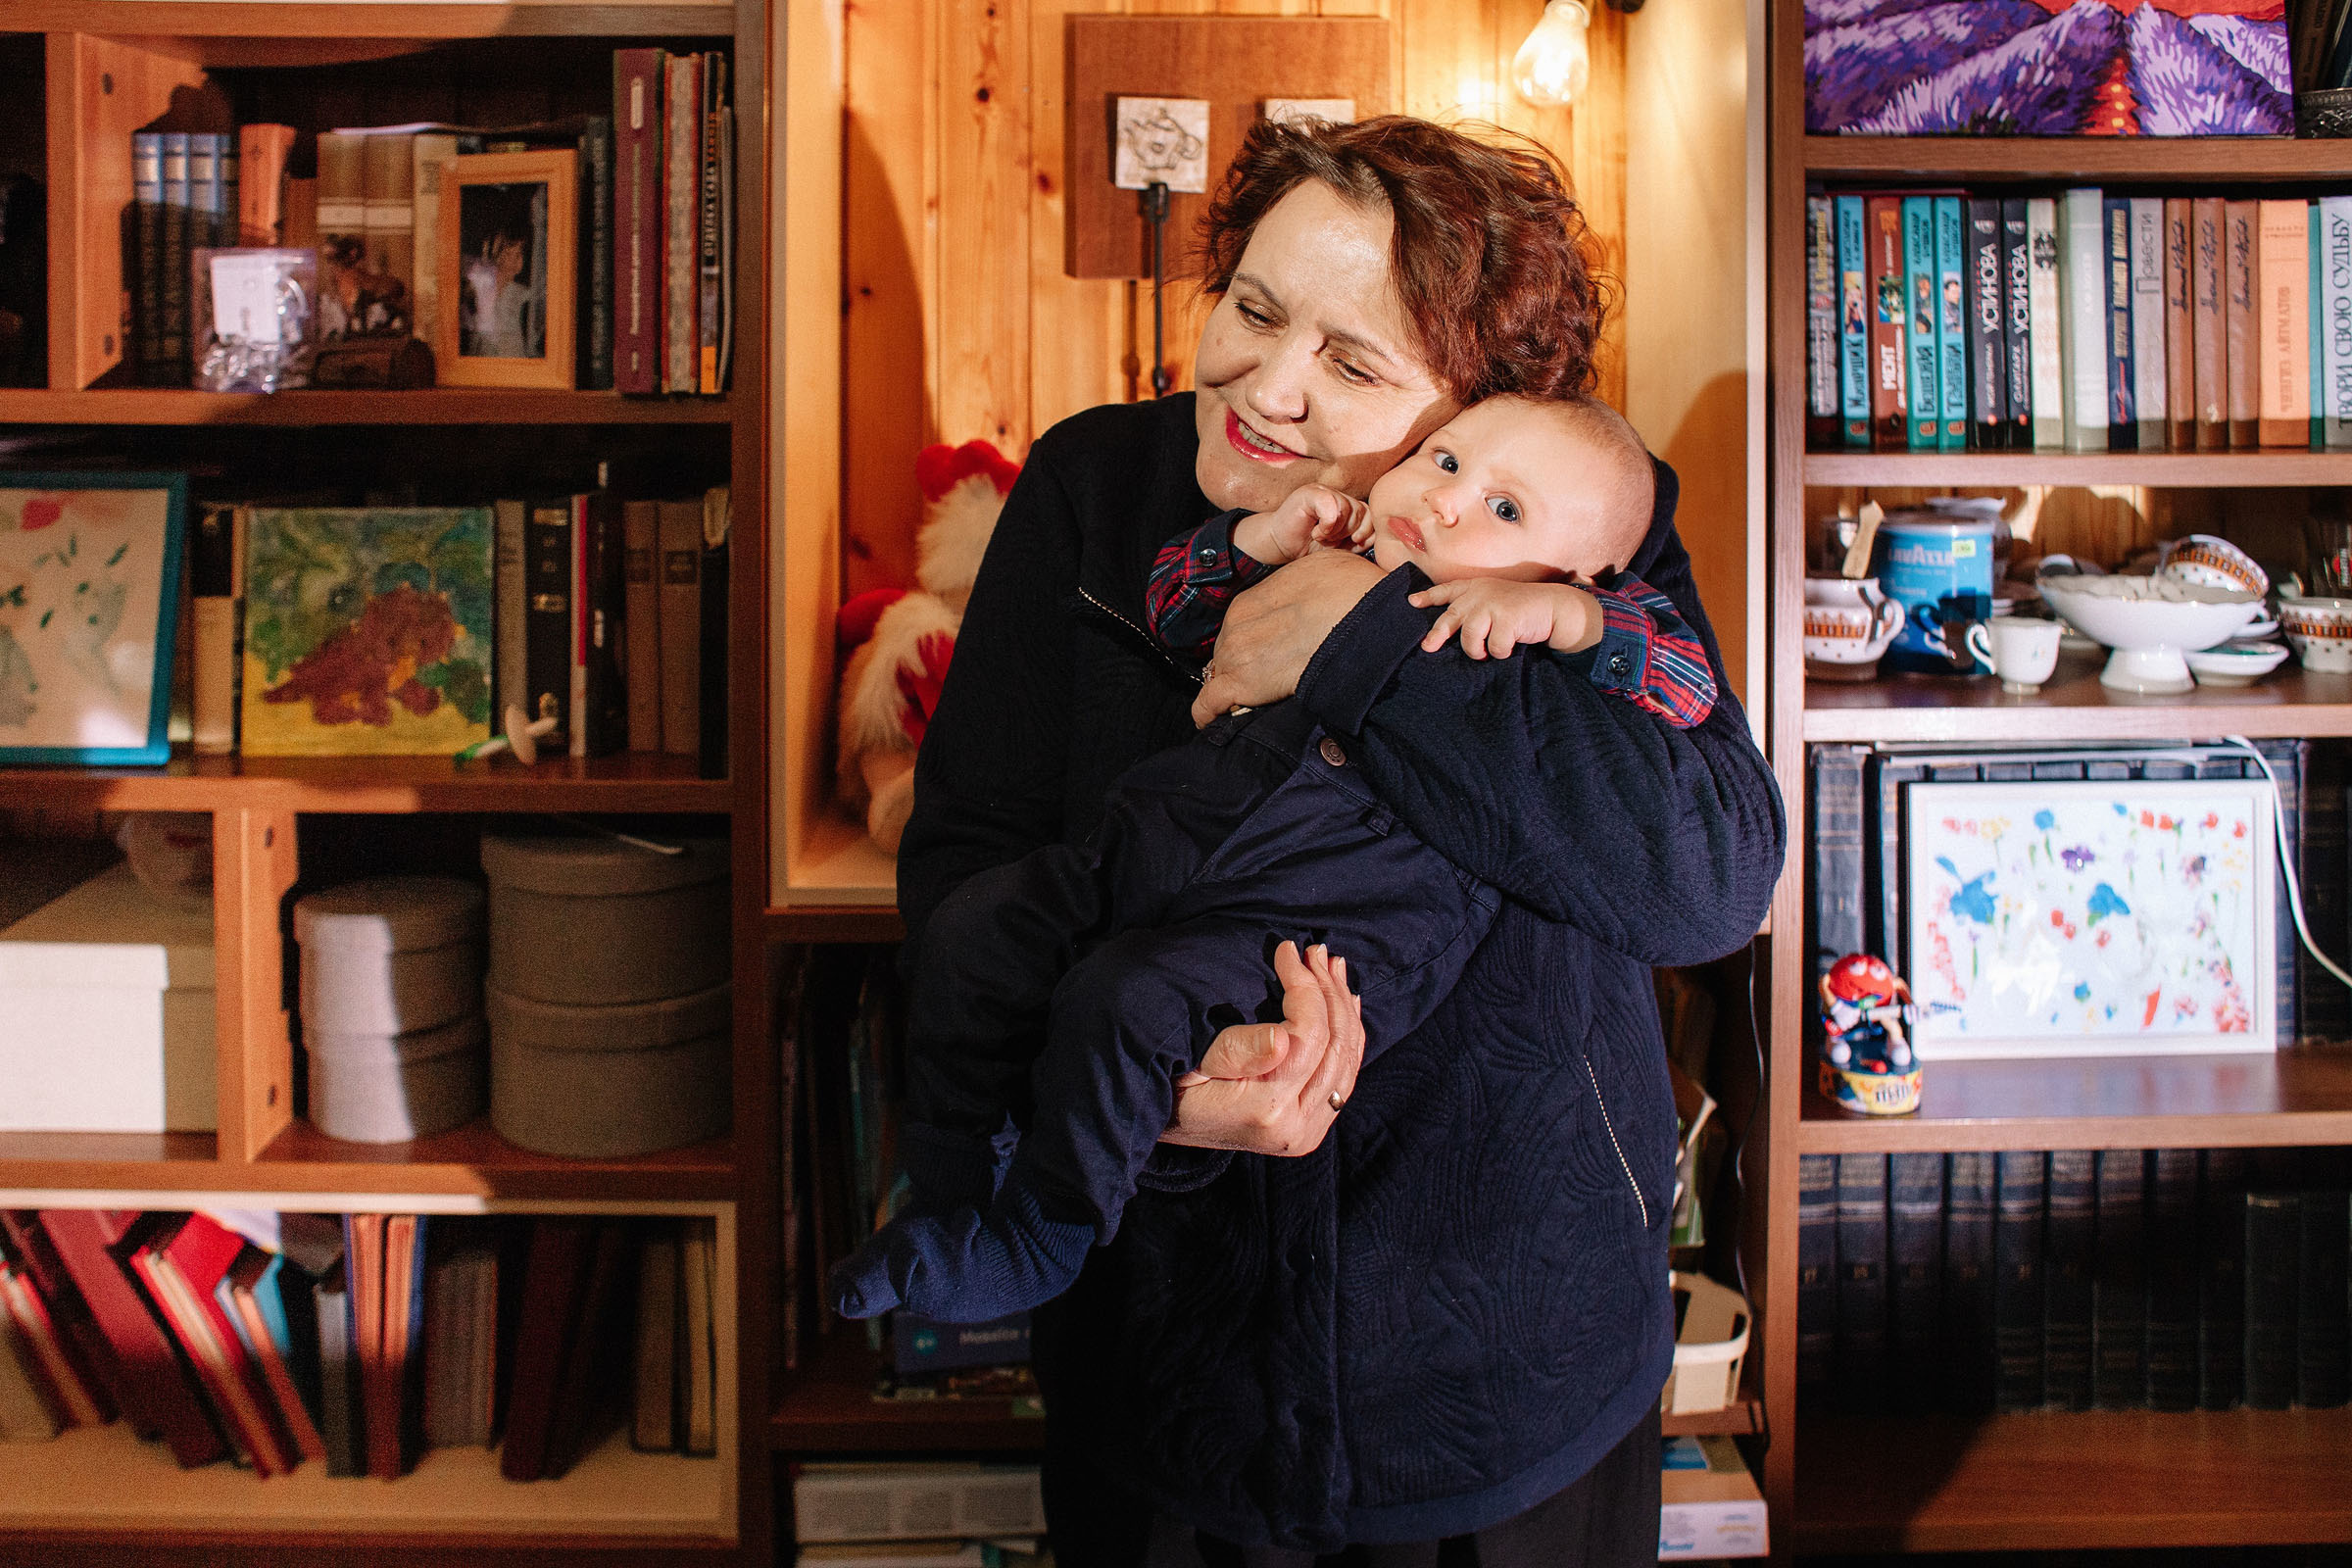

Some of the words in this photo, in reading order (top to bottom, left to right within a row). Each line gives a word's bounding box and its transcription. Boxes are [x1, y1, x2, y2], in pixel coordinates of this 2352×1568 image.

[2135, 213, 2160, 295] Повести
[2331, 213, 2350, 289] СУДЬБУ
[1980, 243, 1999, 334] УСТИНОВА
[2012, 244, 2030, 334] УСТИНОВА
[2277, 286, 2291, 355] АЙТМАТОВ
[2333, 296, 2351, 357] СВОЮ
[1883, 344, 1896, 391] МЕНТ
[2335, 364, 2352, 430] ТВОРИ
